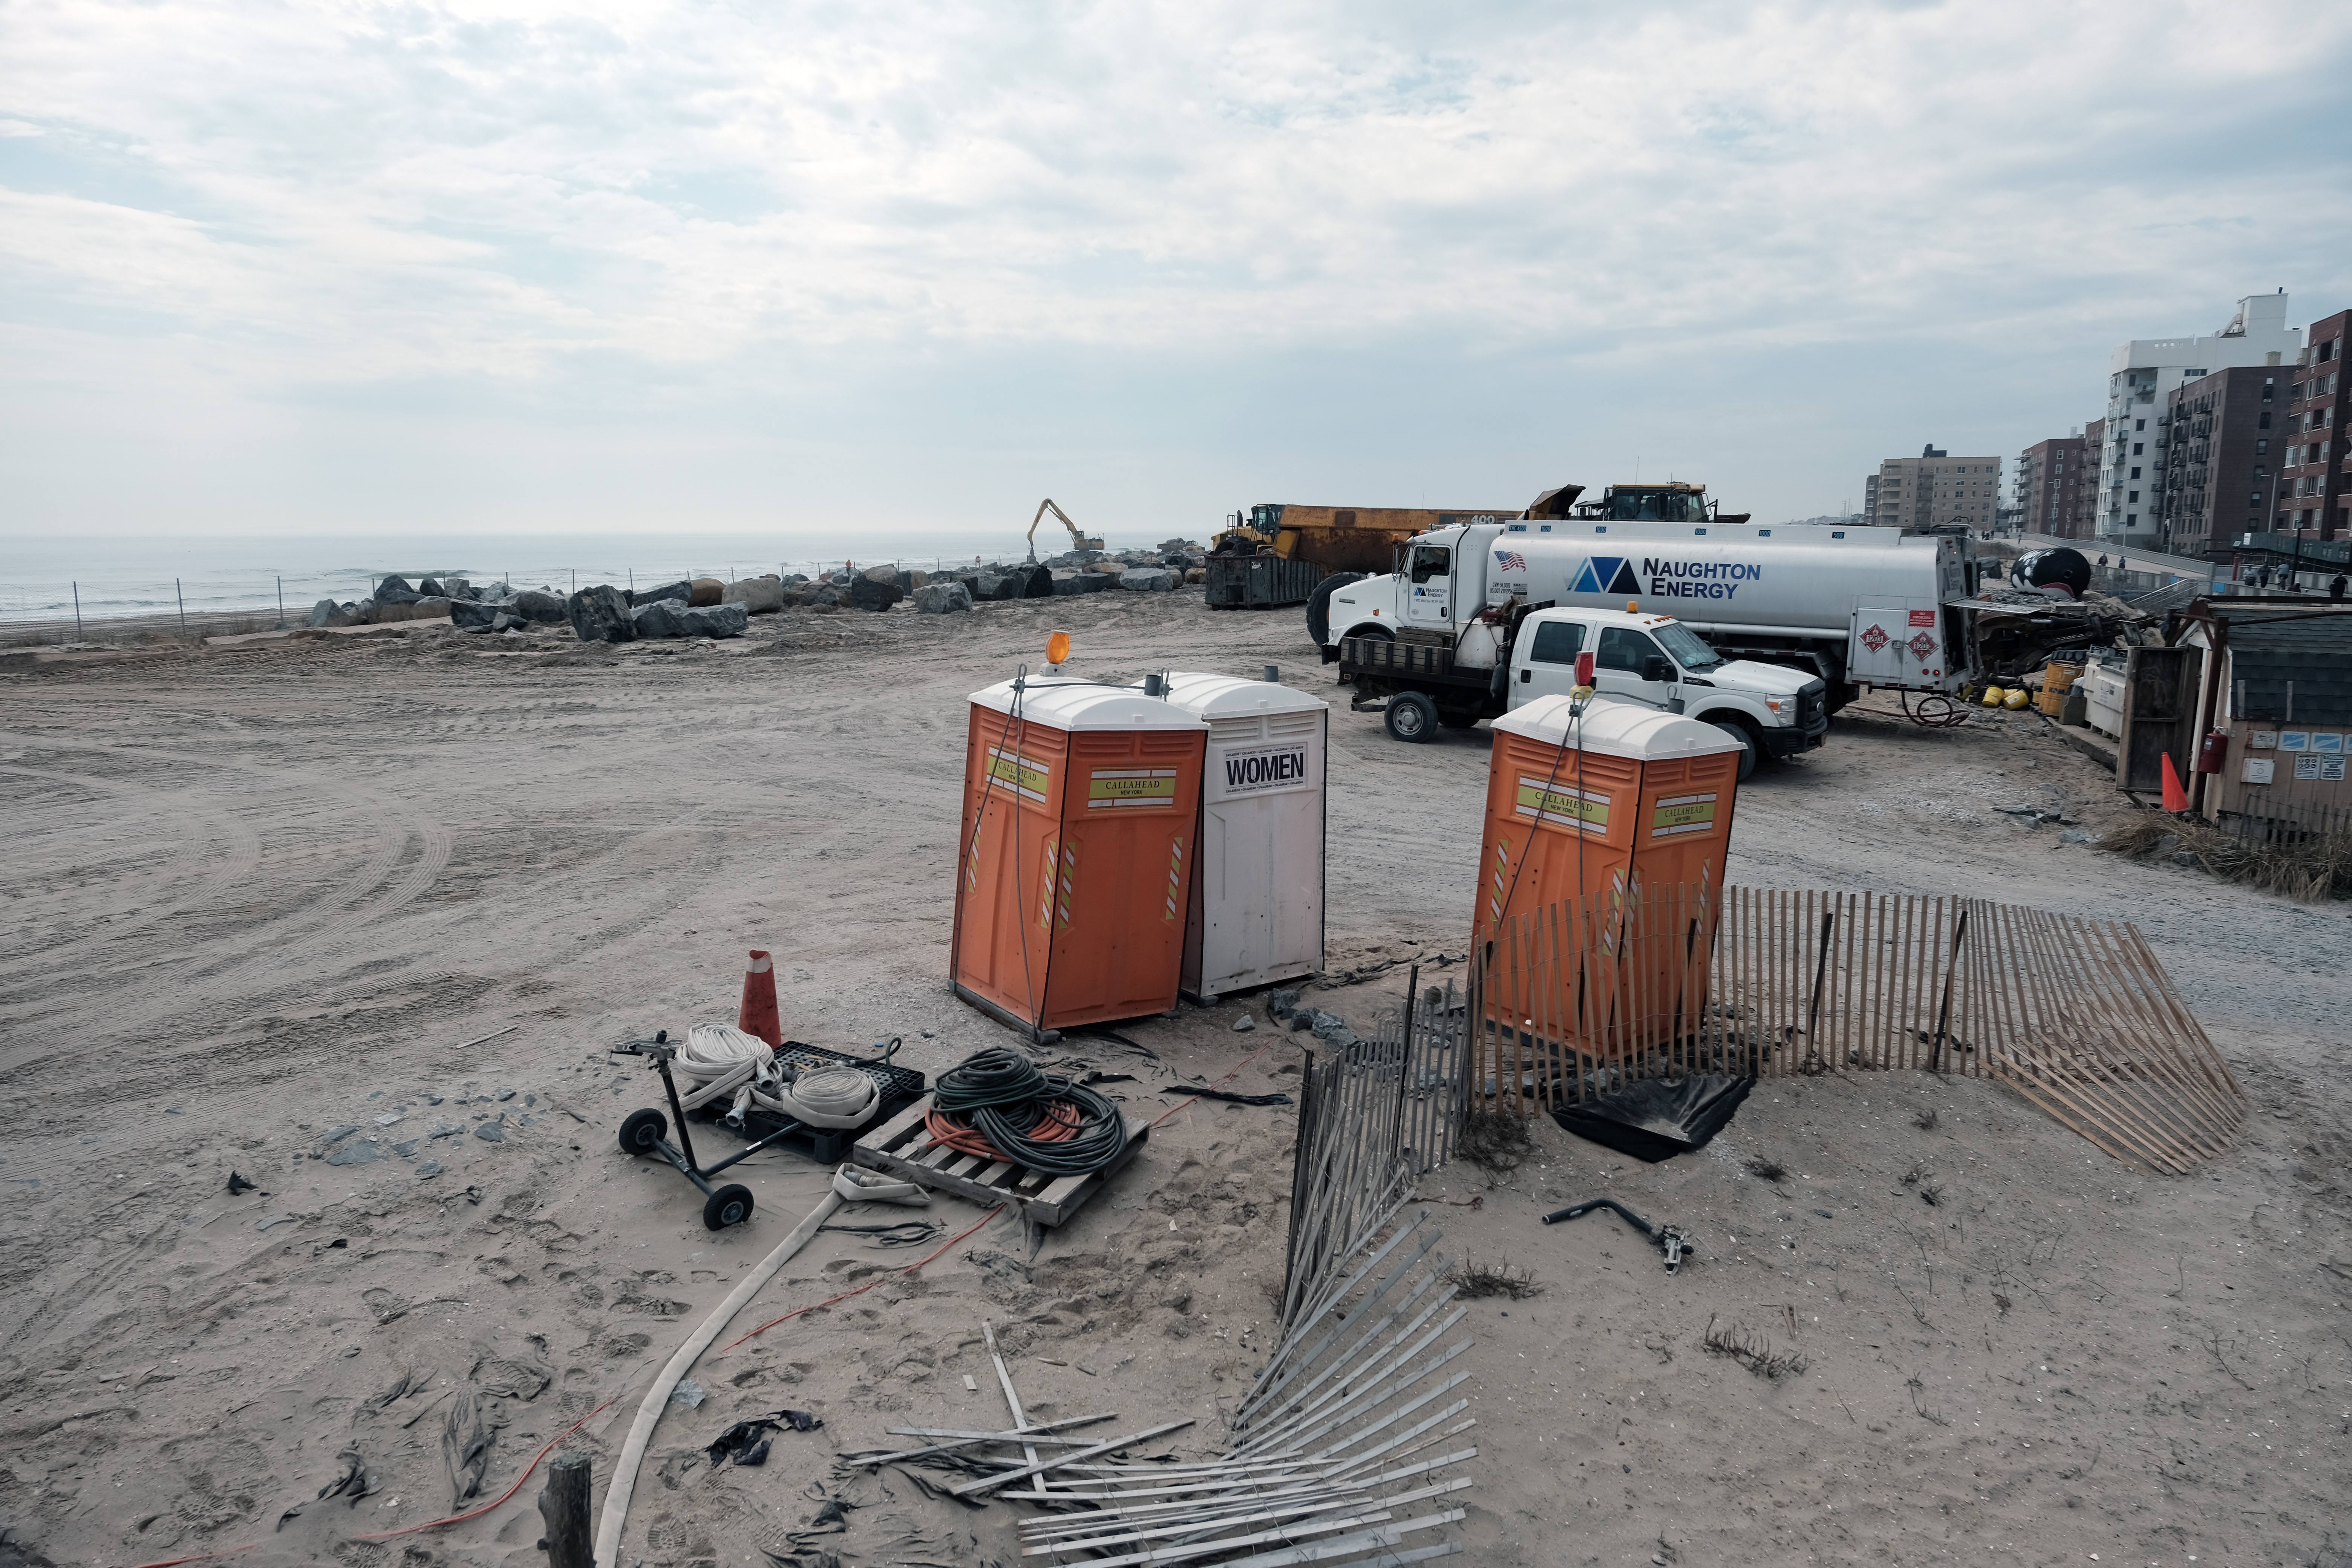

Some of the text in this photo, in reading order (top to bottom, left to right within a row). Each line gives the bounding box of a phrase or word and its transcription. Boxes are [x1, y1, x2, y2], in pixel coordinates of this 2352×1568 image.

[1643, 557, 1761, 580] NAUGHTON
[1651, 577, 1739, 599] ENERGY
[1226, 752, 1303, 786] WOMEN
[1106, 781, 1160, 789] CALLAHEAD
[1665, 805, 1704, 817] CALLAHEAD
